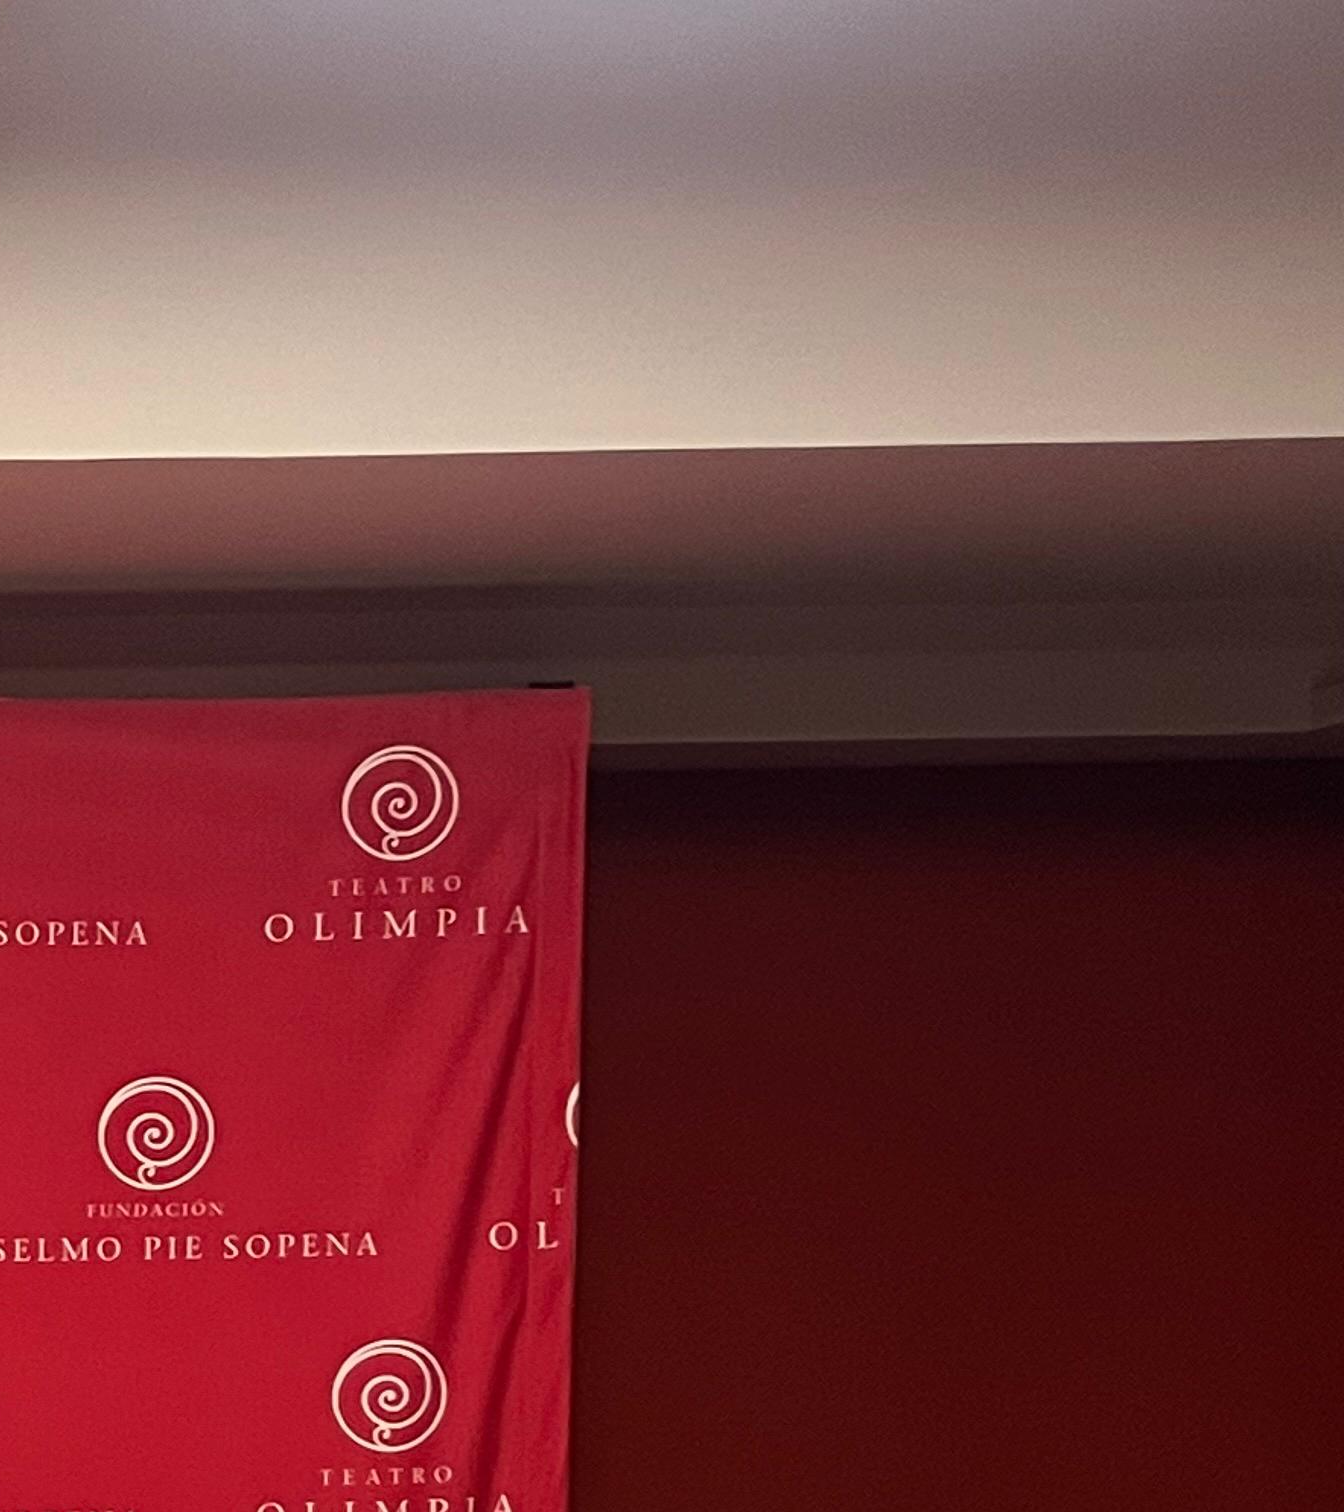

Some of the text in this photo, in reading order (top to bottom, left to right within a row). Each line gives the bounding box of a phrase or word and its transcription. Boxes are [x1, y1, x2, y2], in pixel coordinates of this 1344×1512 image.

[330, 875, 462, 897] TEATRO
[264, 905, 529, 943] OLIMPIA
[87, 1199, 223, 1218] FUNDACIÓN
[144, 1235, 203, 1261] PIE
[223, 1231, 378, 1260] SOPENA
[321, 1465, 453, 1487] TEATRO
